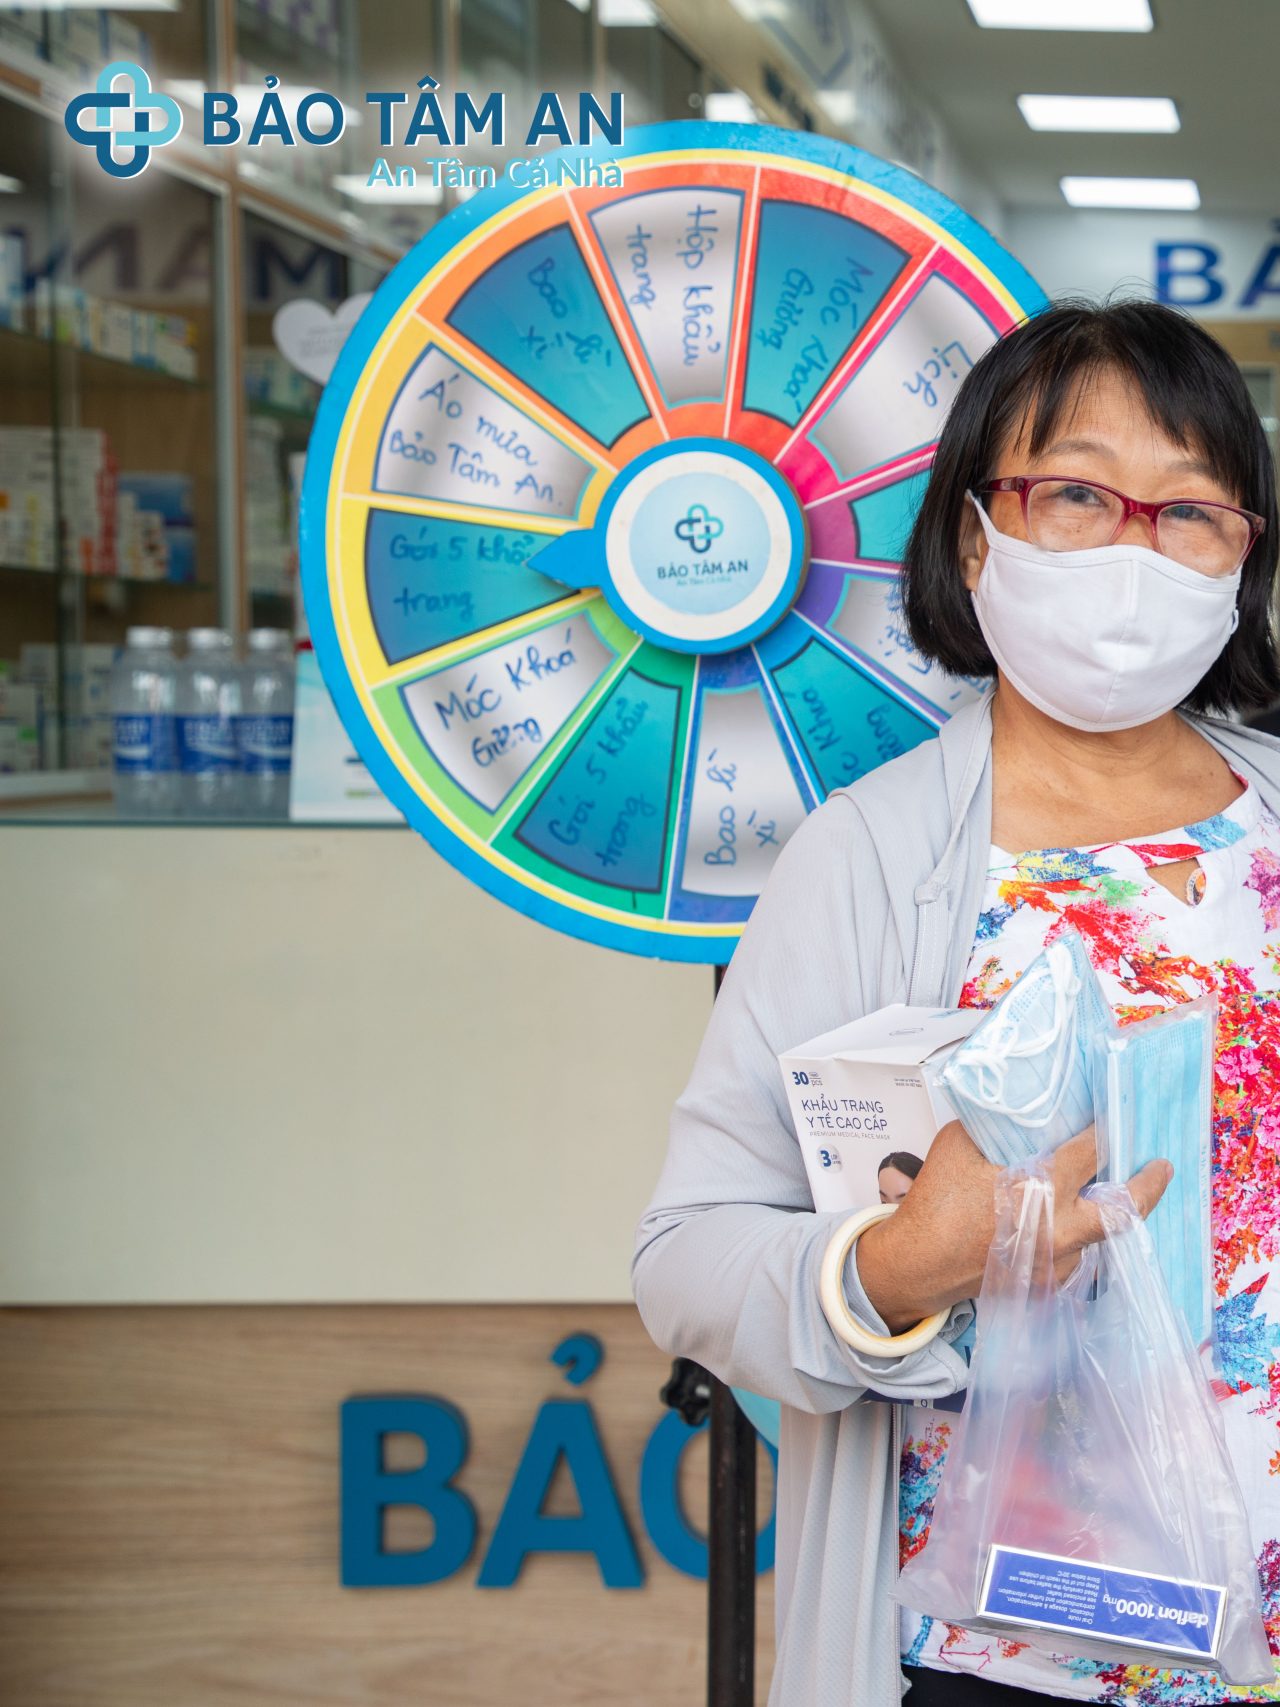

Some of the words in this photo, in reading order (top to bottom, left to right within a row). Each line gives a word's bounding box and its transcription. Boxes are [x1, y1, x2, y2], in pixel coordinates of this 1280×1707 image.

[676, 204, 718, 271] Hộp
[527, 258, 569, 320] Bao
[419, 373, 463, 418] Áo
[389, 430, 436, 465] Bảo
[448, 442, 500, 487] Tâm
[449, 536, 468, 561] 5
[728, 559, 748, 572] AN
[587, 742, 608, 784] 5
[704, 806, 737, 868] Bao
[792, 1071, 809, 1085] 30
[801, 1093, 838, 1111] KHẨU
[841, 1099, 884, 1113] TRANG
[806, 1117, 814, 1128] Y
[817, 1112, 834, 1129] TẾ
[835, 1116, 861, 1130] CAO
[864, 1114, 888, 1131] CẤP
[820, 1150, 832, 1167] 3
[340, 1331, 777, 1590] BẢO
